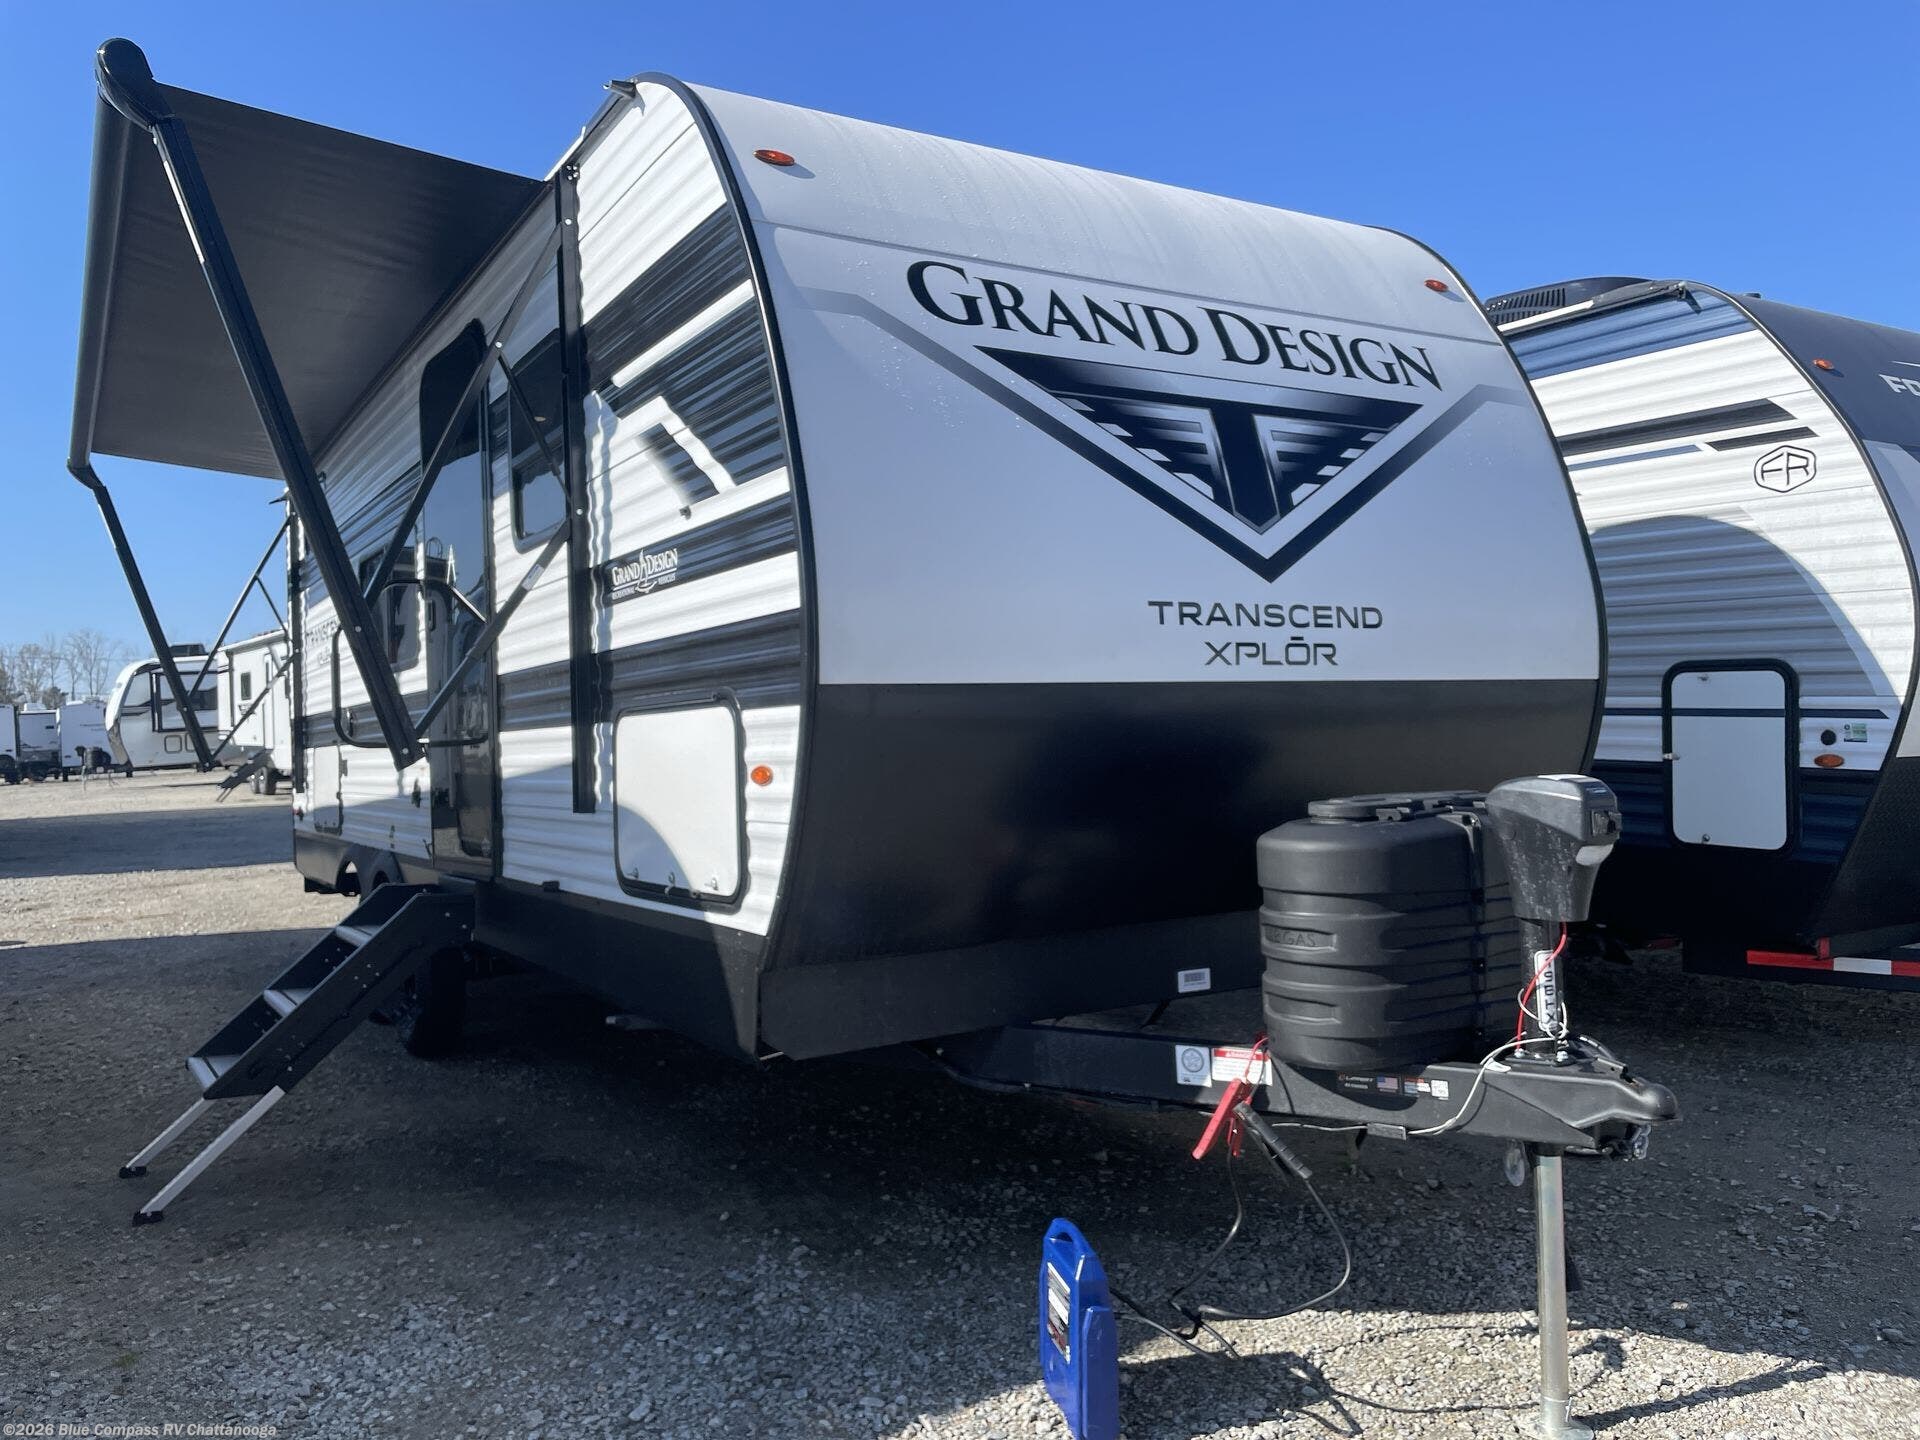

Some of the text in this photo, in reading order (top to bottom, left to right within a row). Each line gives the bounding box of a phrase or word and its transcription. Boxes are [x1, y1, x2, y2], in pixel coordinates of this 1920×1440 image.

[906, 260, 1443, 392] GRAND DESIGN
[1761, 451, 1810, 486] FR
[612, 562, 641, 586] GRAND
[645, 548, 678, 575] DESIGN
[1147, 601, 1384, 630] TRANSCEND
